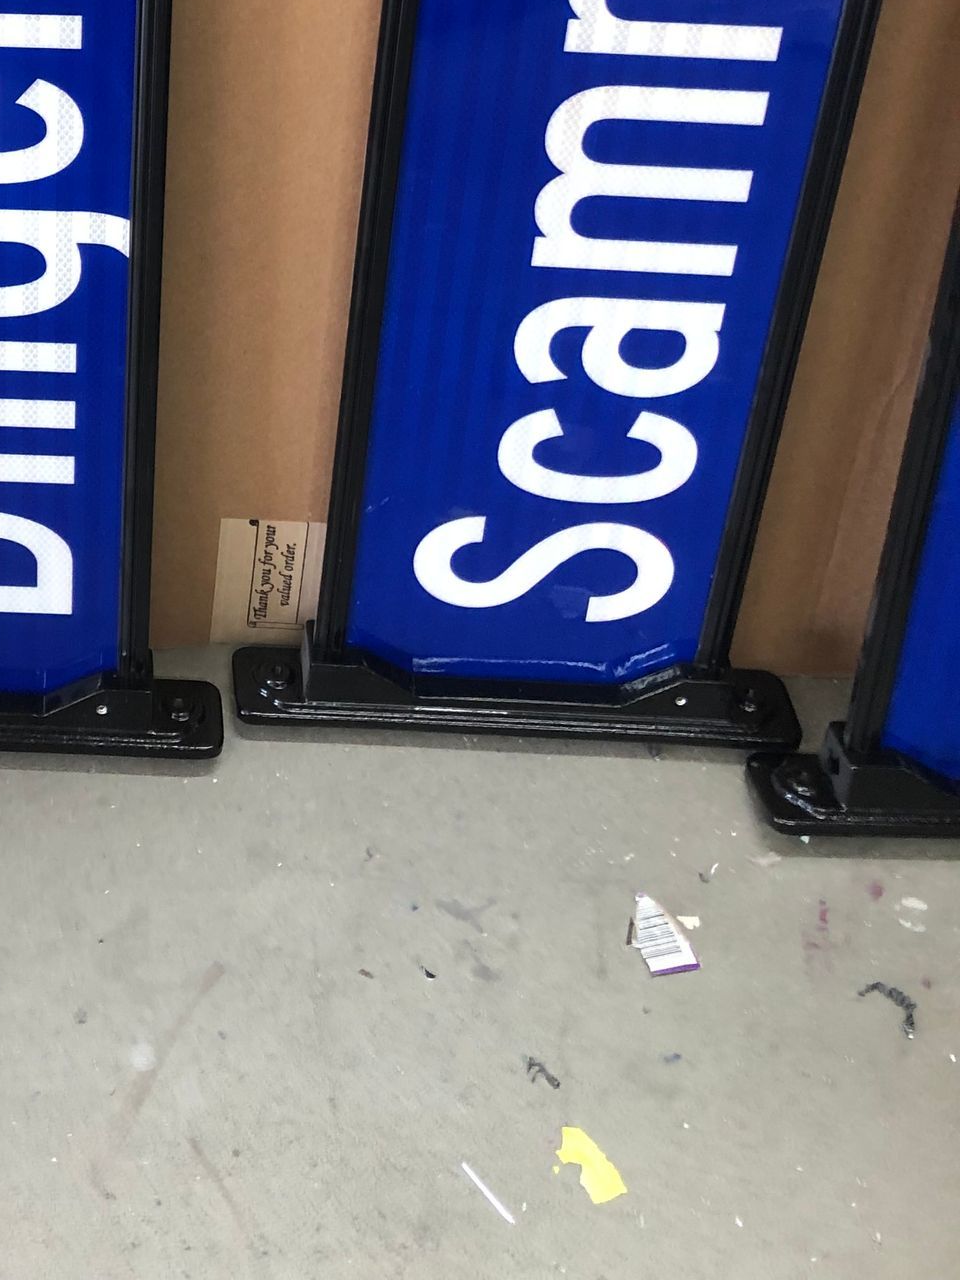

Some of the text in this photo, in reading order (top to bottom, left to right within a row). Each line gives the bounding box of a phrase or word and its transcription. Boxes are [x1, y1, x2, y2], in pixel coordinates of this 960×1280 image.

[253, 525, 278, 620] Thank you for your
[277, 543, 296, 607] valued order.
